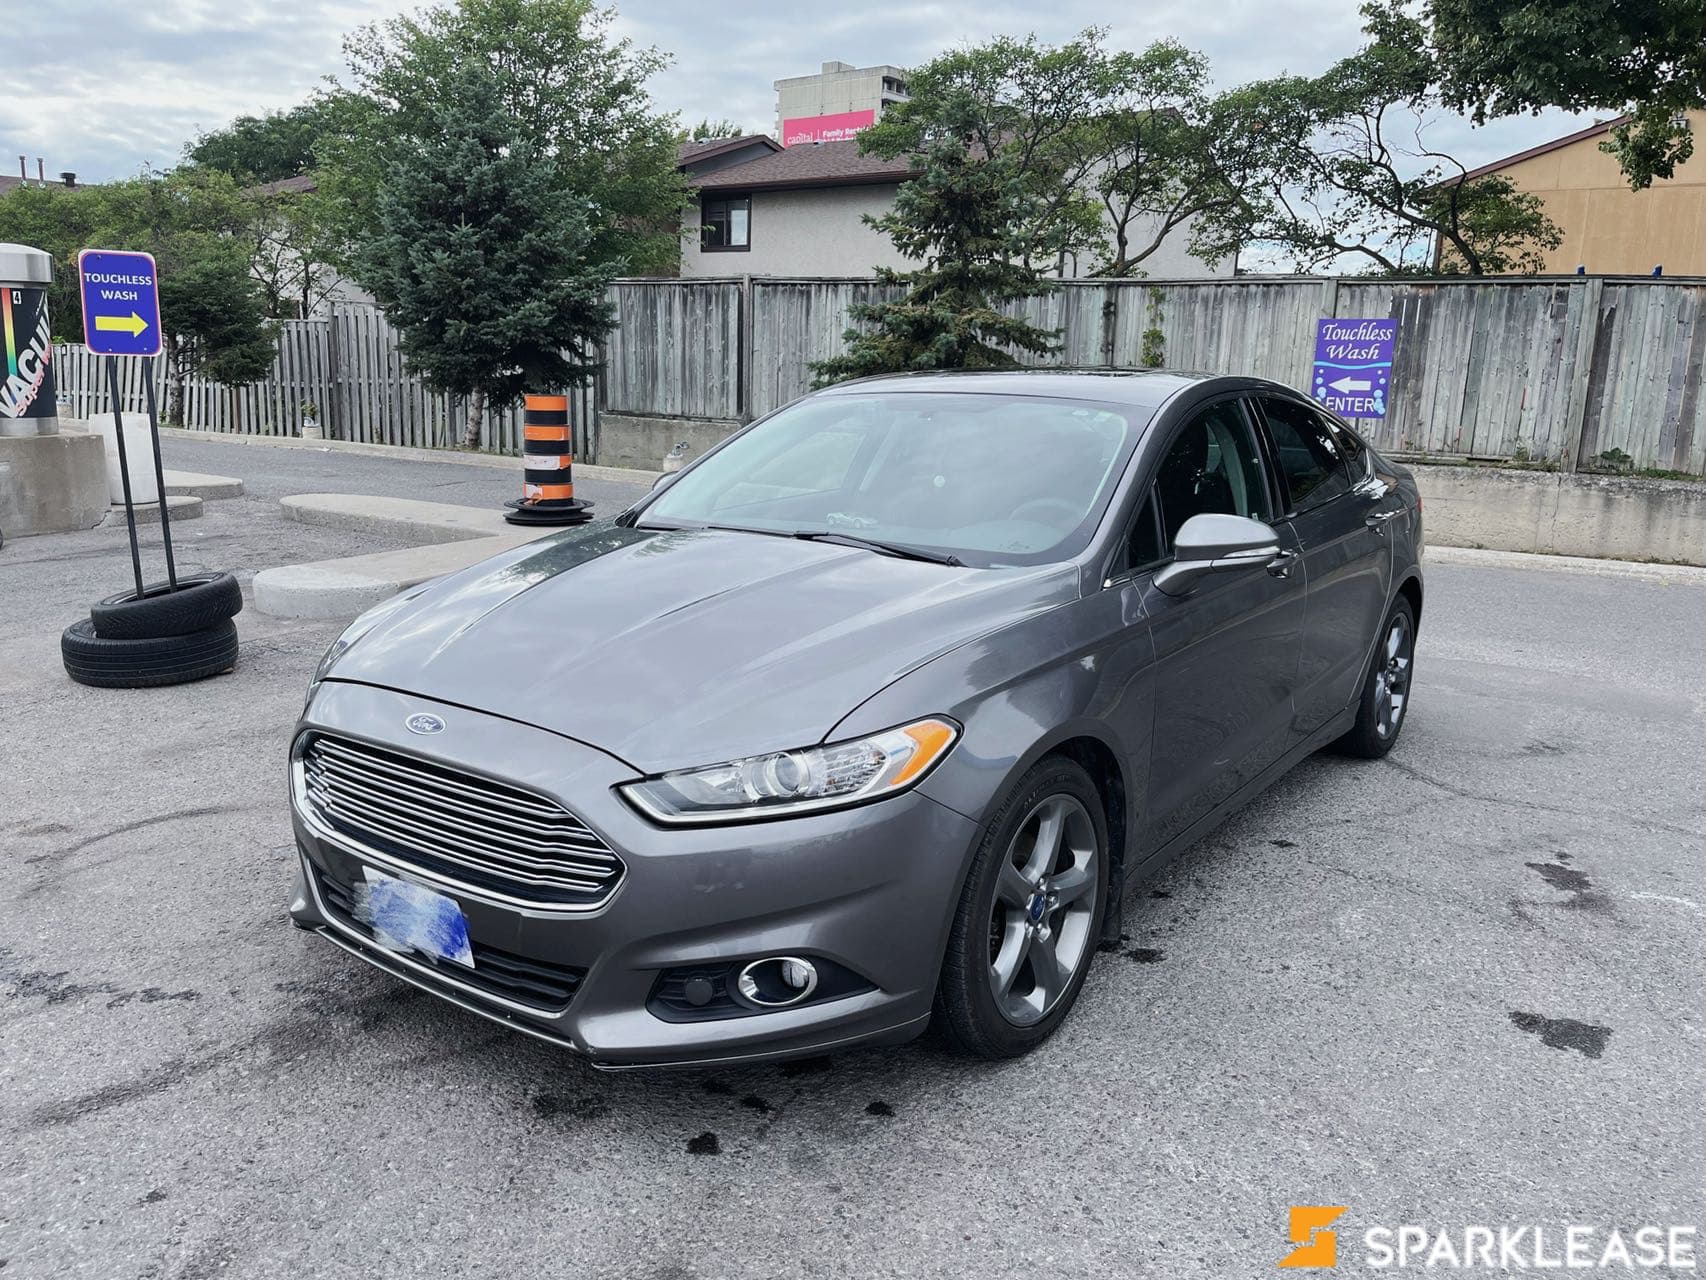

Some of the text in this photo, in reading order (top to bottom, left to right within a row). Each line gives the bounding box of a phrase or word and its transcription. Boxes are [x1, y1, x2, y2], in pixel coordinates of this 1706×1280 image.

[822, 129, 844, 138] Family
[84, 272, 152, 286] TOUCHLESS
[14, 291, 20, 304] 4
[101, 289, 138, 301] WASH
[1322, 322, 1393, 341] Touchless
[1326, 343, 1380, 360] Wash
[1326, 396, 1375, 412] ENTER
